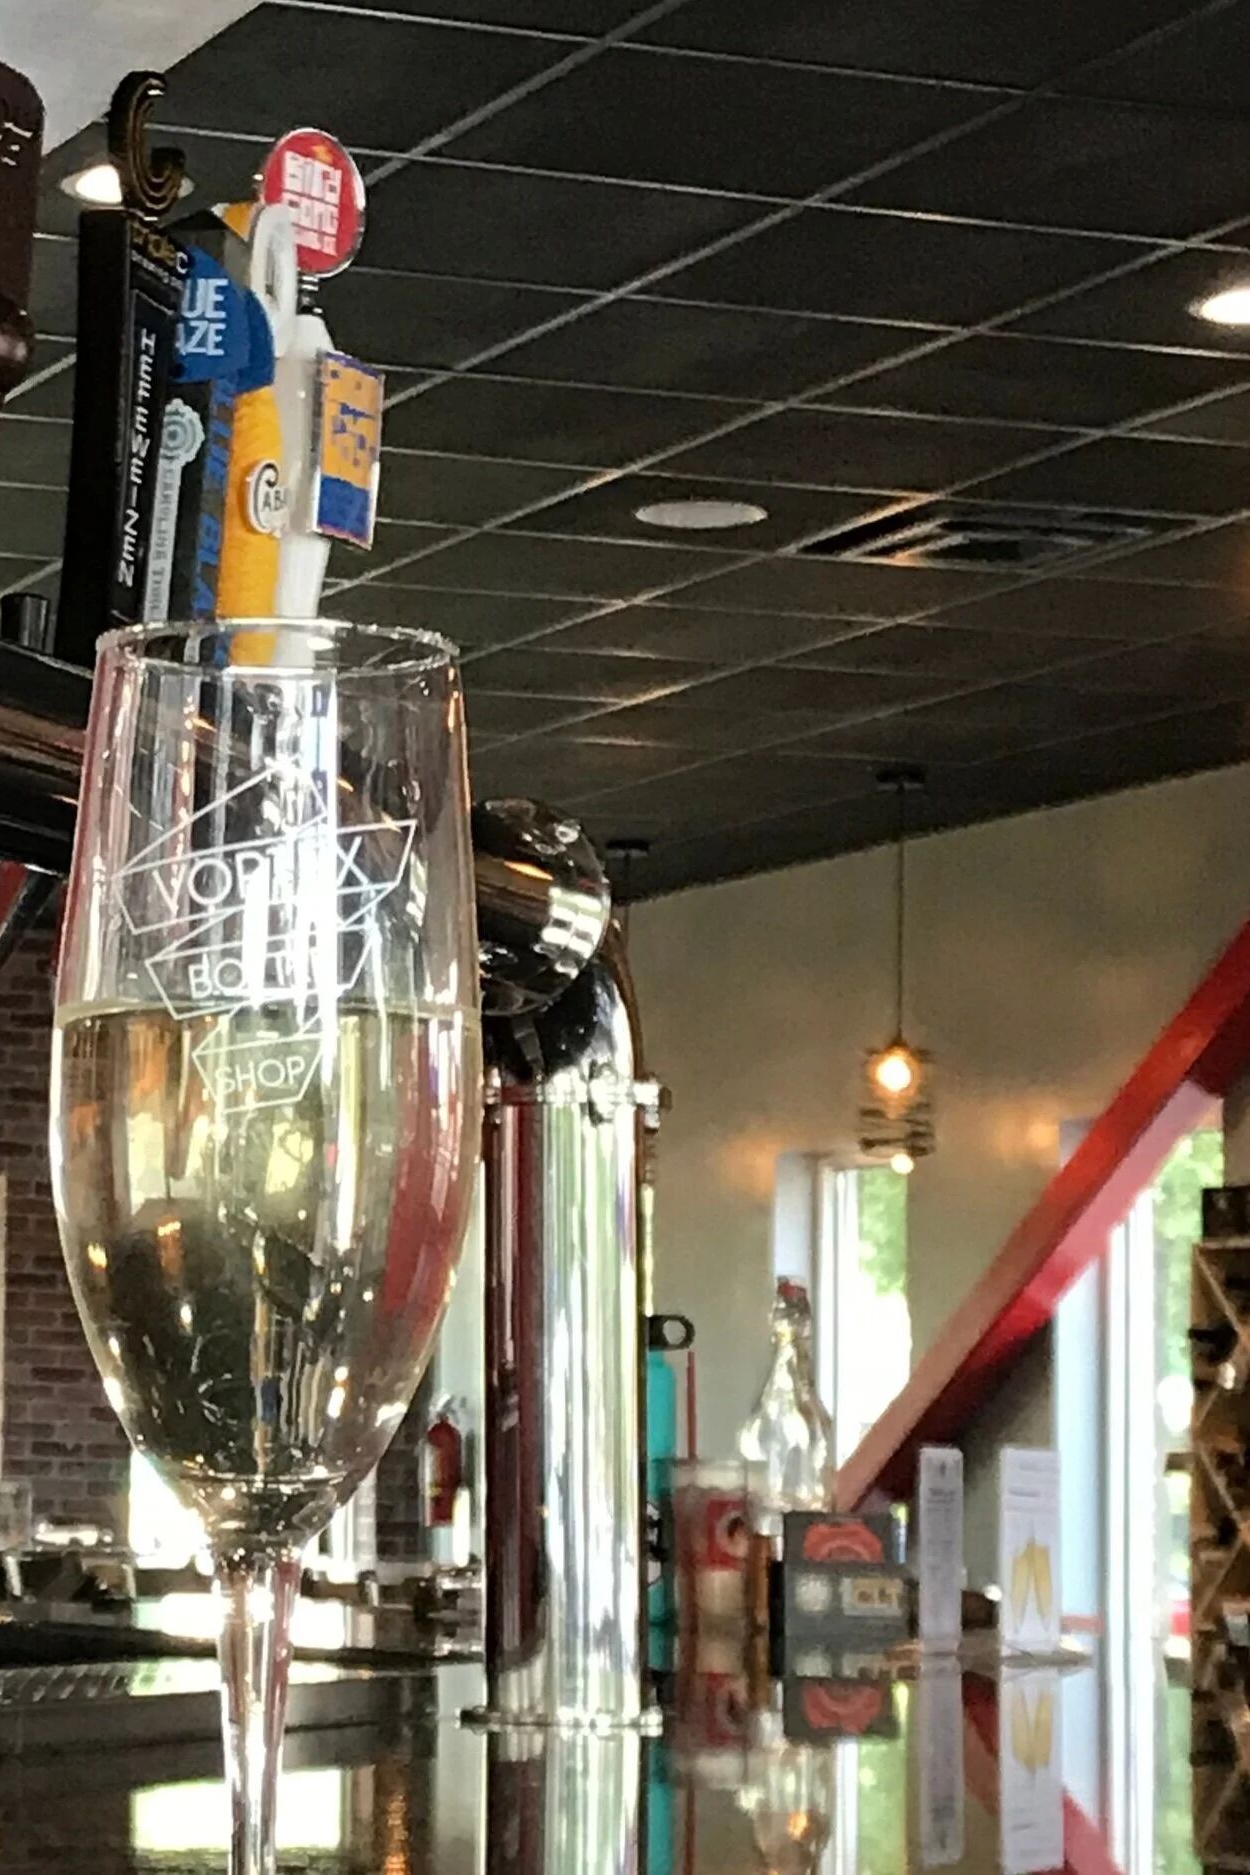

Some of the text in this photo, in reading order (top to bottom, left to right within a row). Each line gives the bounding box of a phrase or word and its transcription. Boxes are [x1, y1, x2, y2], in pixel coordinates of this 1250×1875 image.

[180, 277, 229, 318] UE
[117, 327, 157, 588] HEFEWEIZEN
[215, 1060, 306, 1096] SHOP
